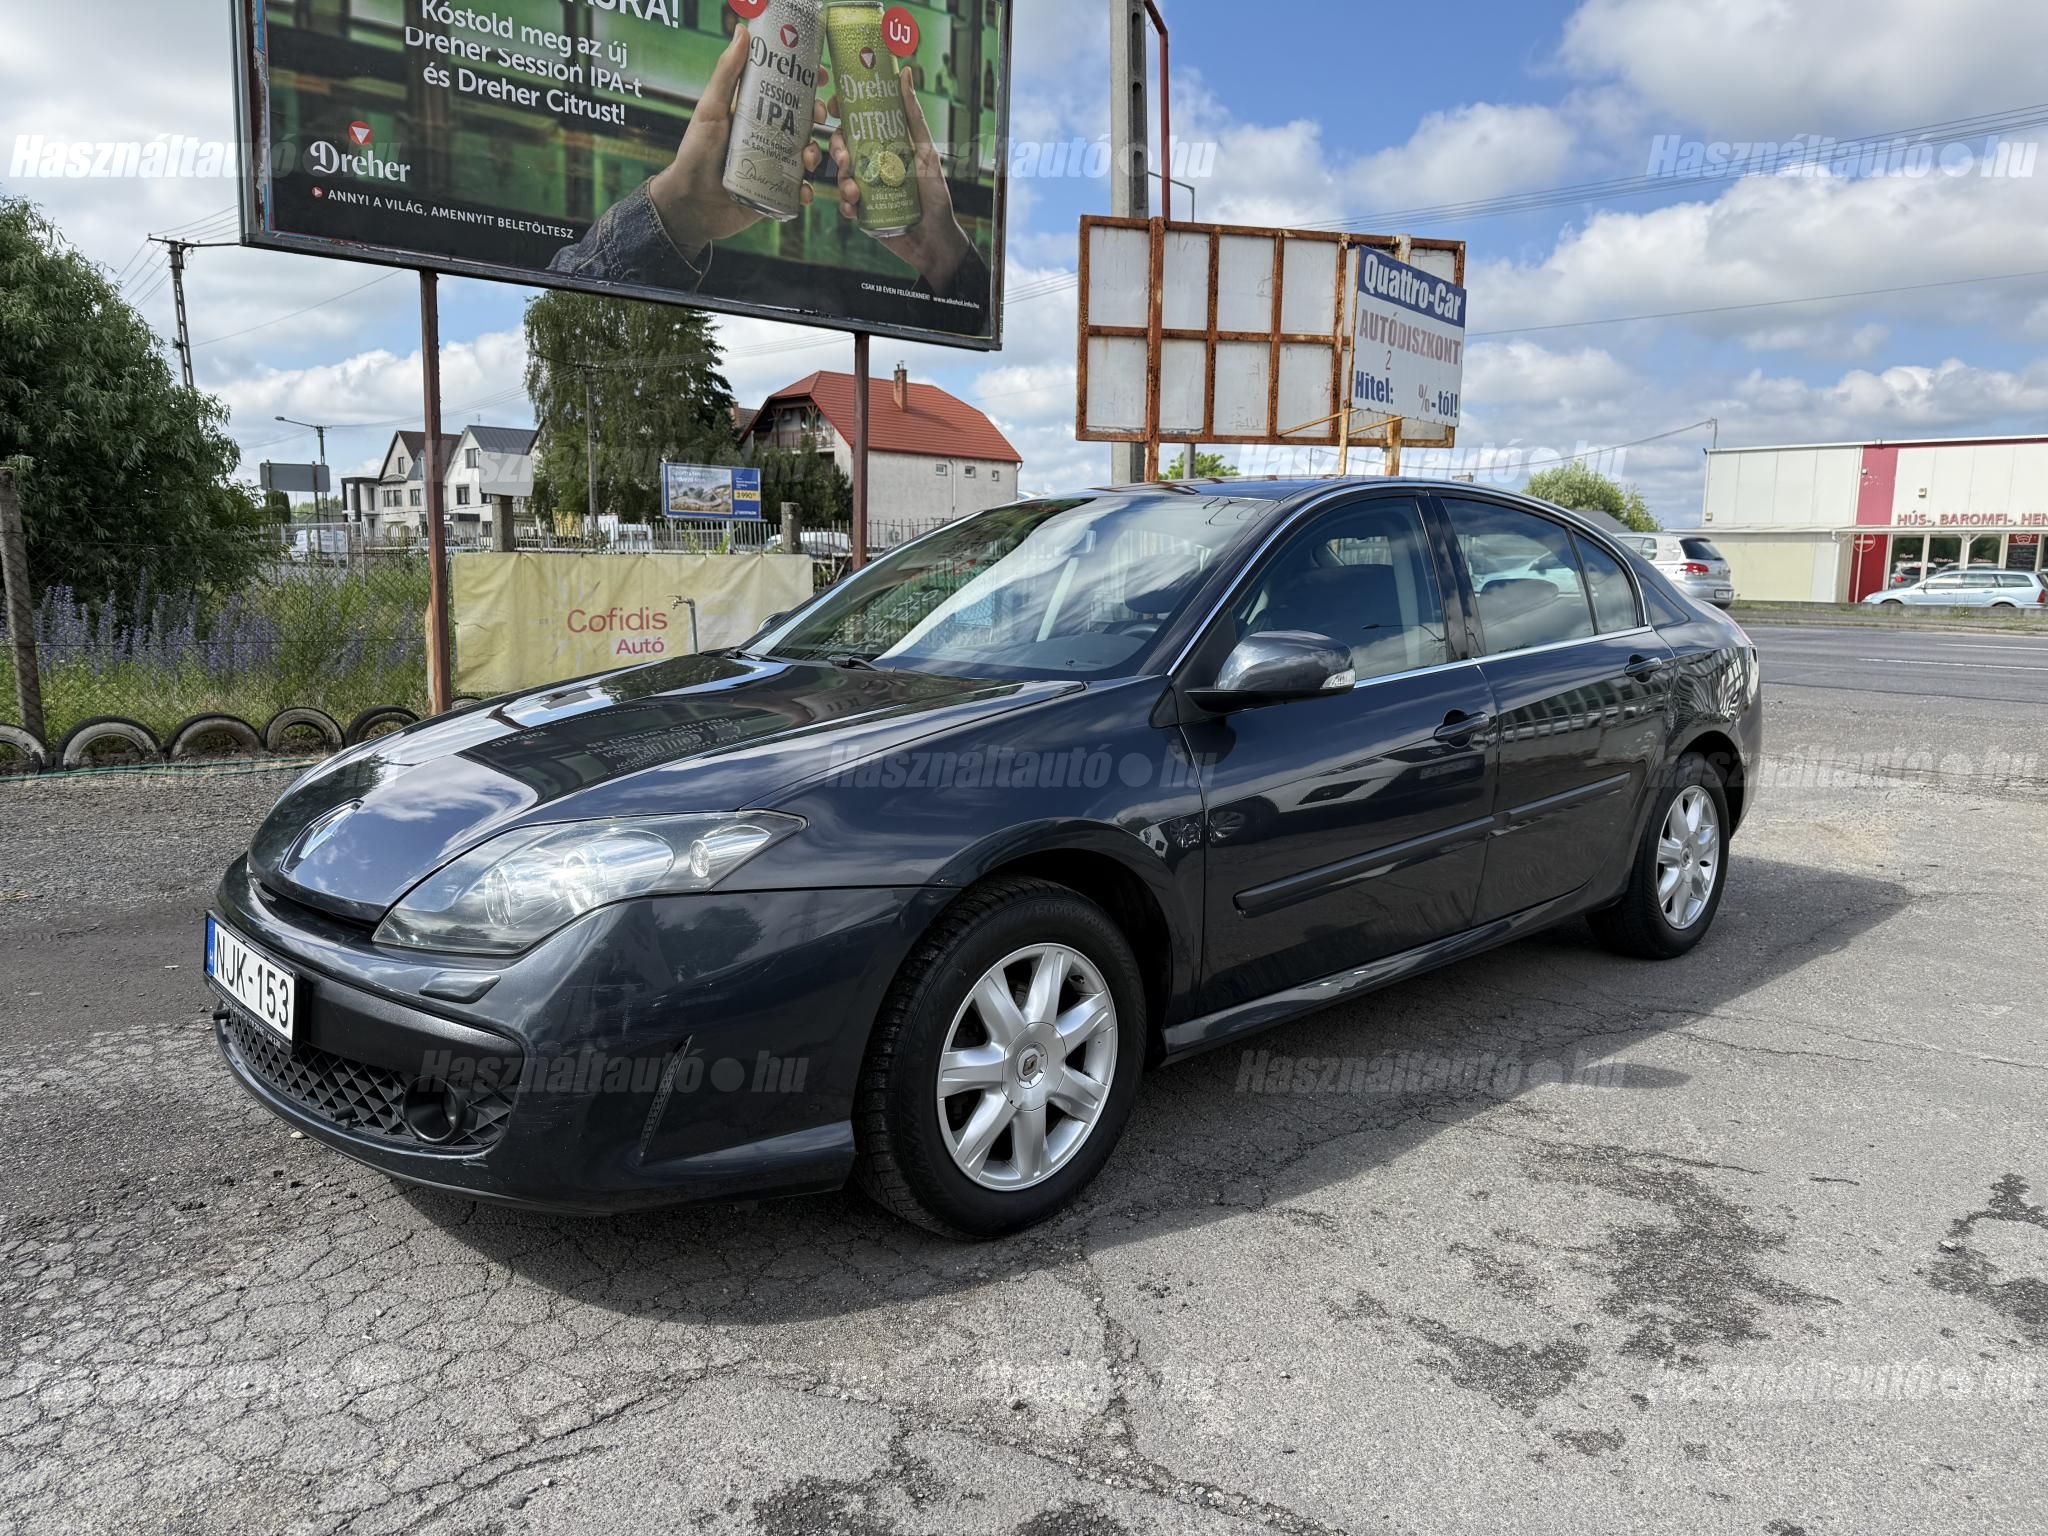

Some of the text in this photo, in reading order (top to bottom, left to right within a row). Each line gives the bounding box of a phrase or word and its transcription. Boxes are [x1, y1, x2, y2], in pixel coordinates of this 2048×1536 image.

[421, 0, 628, 69] Kóstold meg az új
[889, 18, 911, 44] ÚJ
[405, 26, 643, 99] Dreher Session IPA-t
[423, 62, 626, 126] és Dreher Citrust!
[759, 80, 800, 110] SESSION
[756, 96, 796, 136] IPA
[848, 110, 906, 141] CITRUS
[310, 140, 411, 183] Dreher
[328, 189, 574, 239] ANNYI A VILÁG, AMENNYIT BELETÖLTESZ
[1364, 253, 1462, 321] Quattro-Car
[1359, 309, 1461, 365] AUTÓDISZKONT
[1385, 350, 1391, 371] 2
[1355, 370, 1394, 405] Hitel:
[1940, 513, 2017, 526] BAROMFI-,
[567, 606, 668, 633] Cofidis
[616, 637, 665, 654] Autó
[216, 931, 289, 1028] NJK-153
